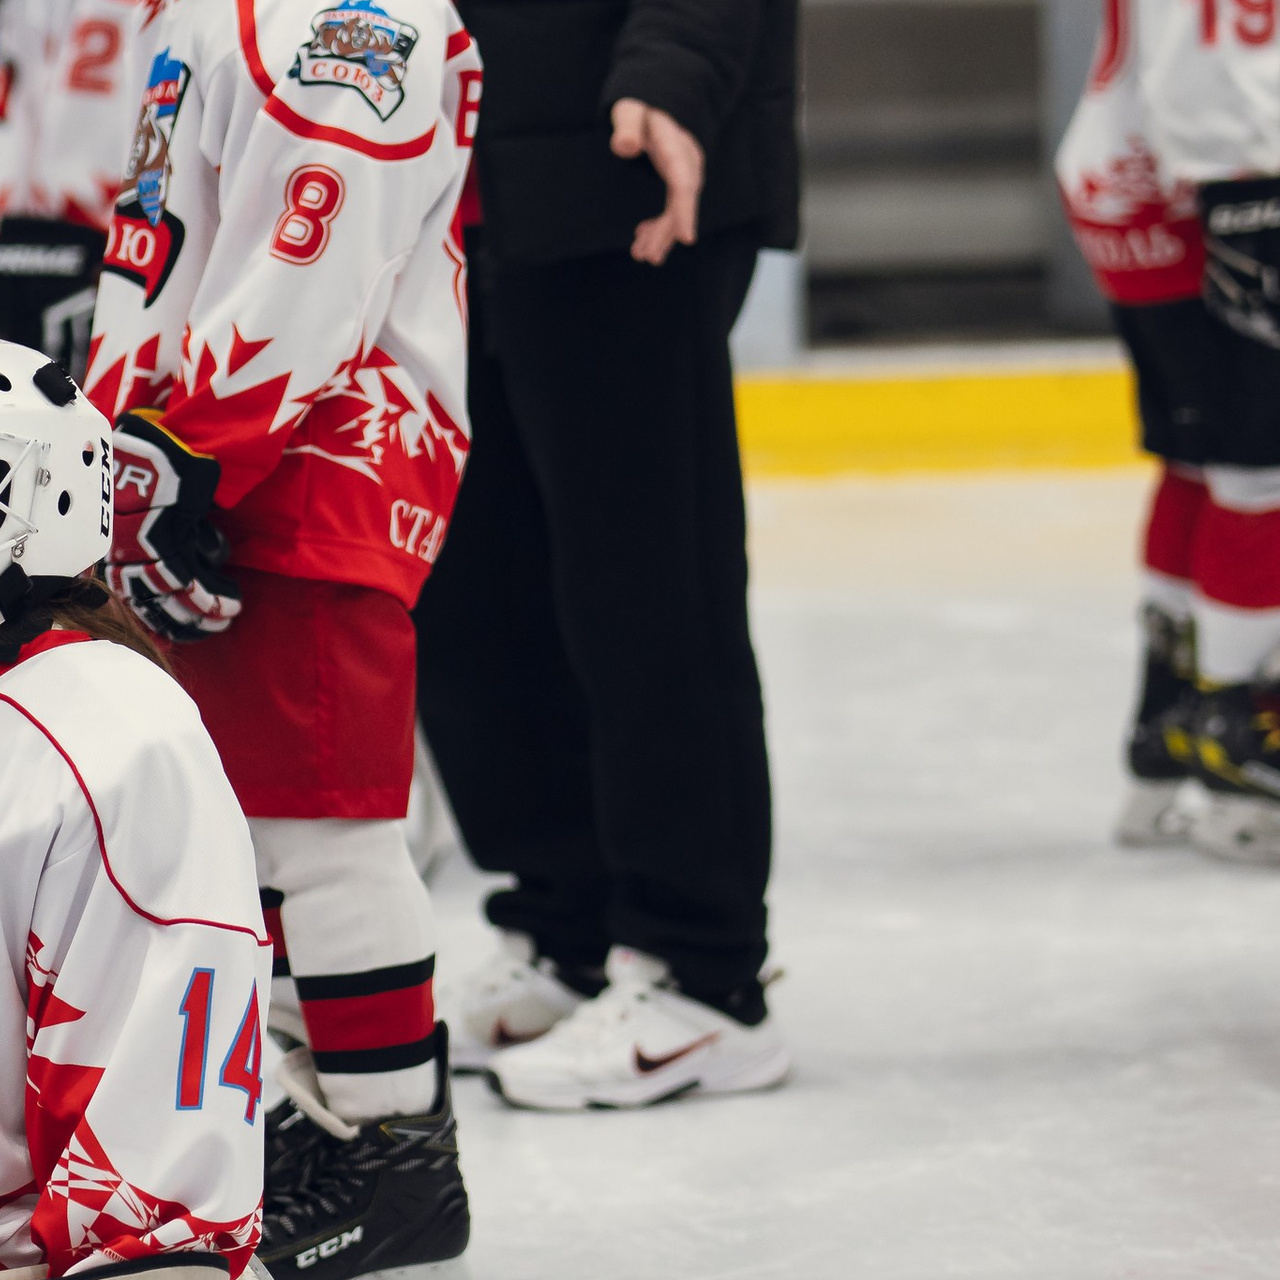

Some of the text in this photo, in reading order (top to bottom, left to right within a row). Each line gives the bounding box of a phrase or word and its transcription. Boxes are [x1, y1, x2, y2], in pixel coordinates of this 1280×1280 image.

[269, 164, 346, 267] 8
[100, 437, 111, 538] CCM
[175, 967, 263, 1127] 14
[294, 1225, 364, 1269] CCM
